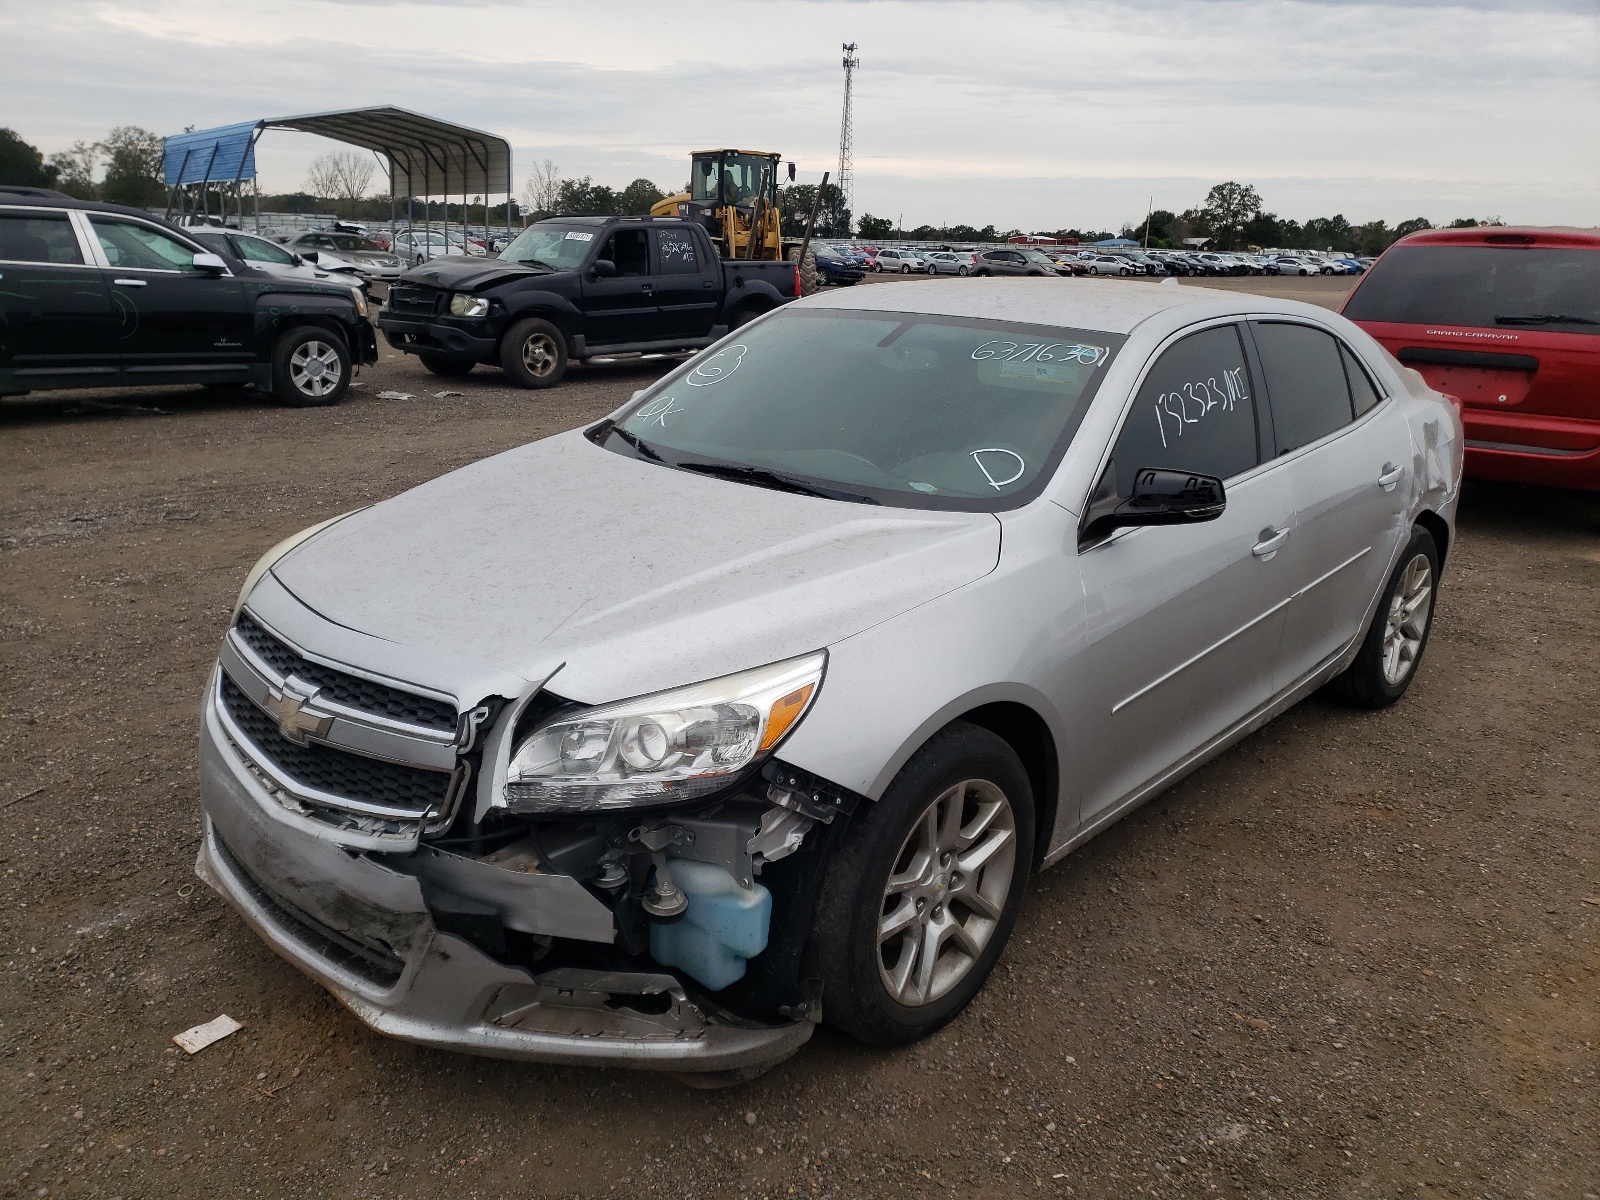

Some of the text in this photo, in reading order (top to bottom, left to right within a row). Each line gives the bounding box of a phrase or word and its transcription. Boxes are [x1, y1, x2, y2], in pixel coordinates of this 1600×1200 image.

[1426, 329, 1518, 340] GRAND CARAVAN
[969, 448, 1025, 492] D
